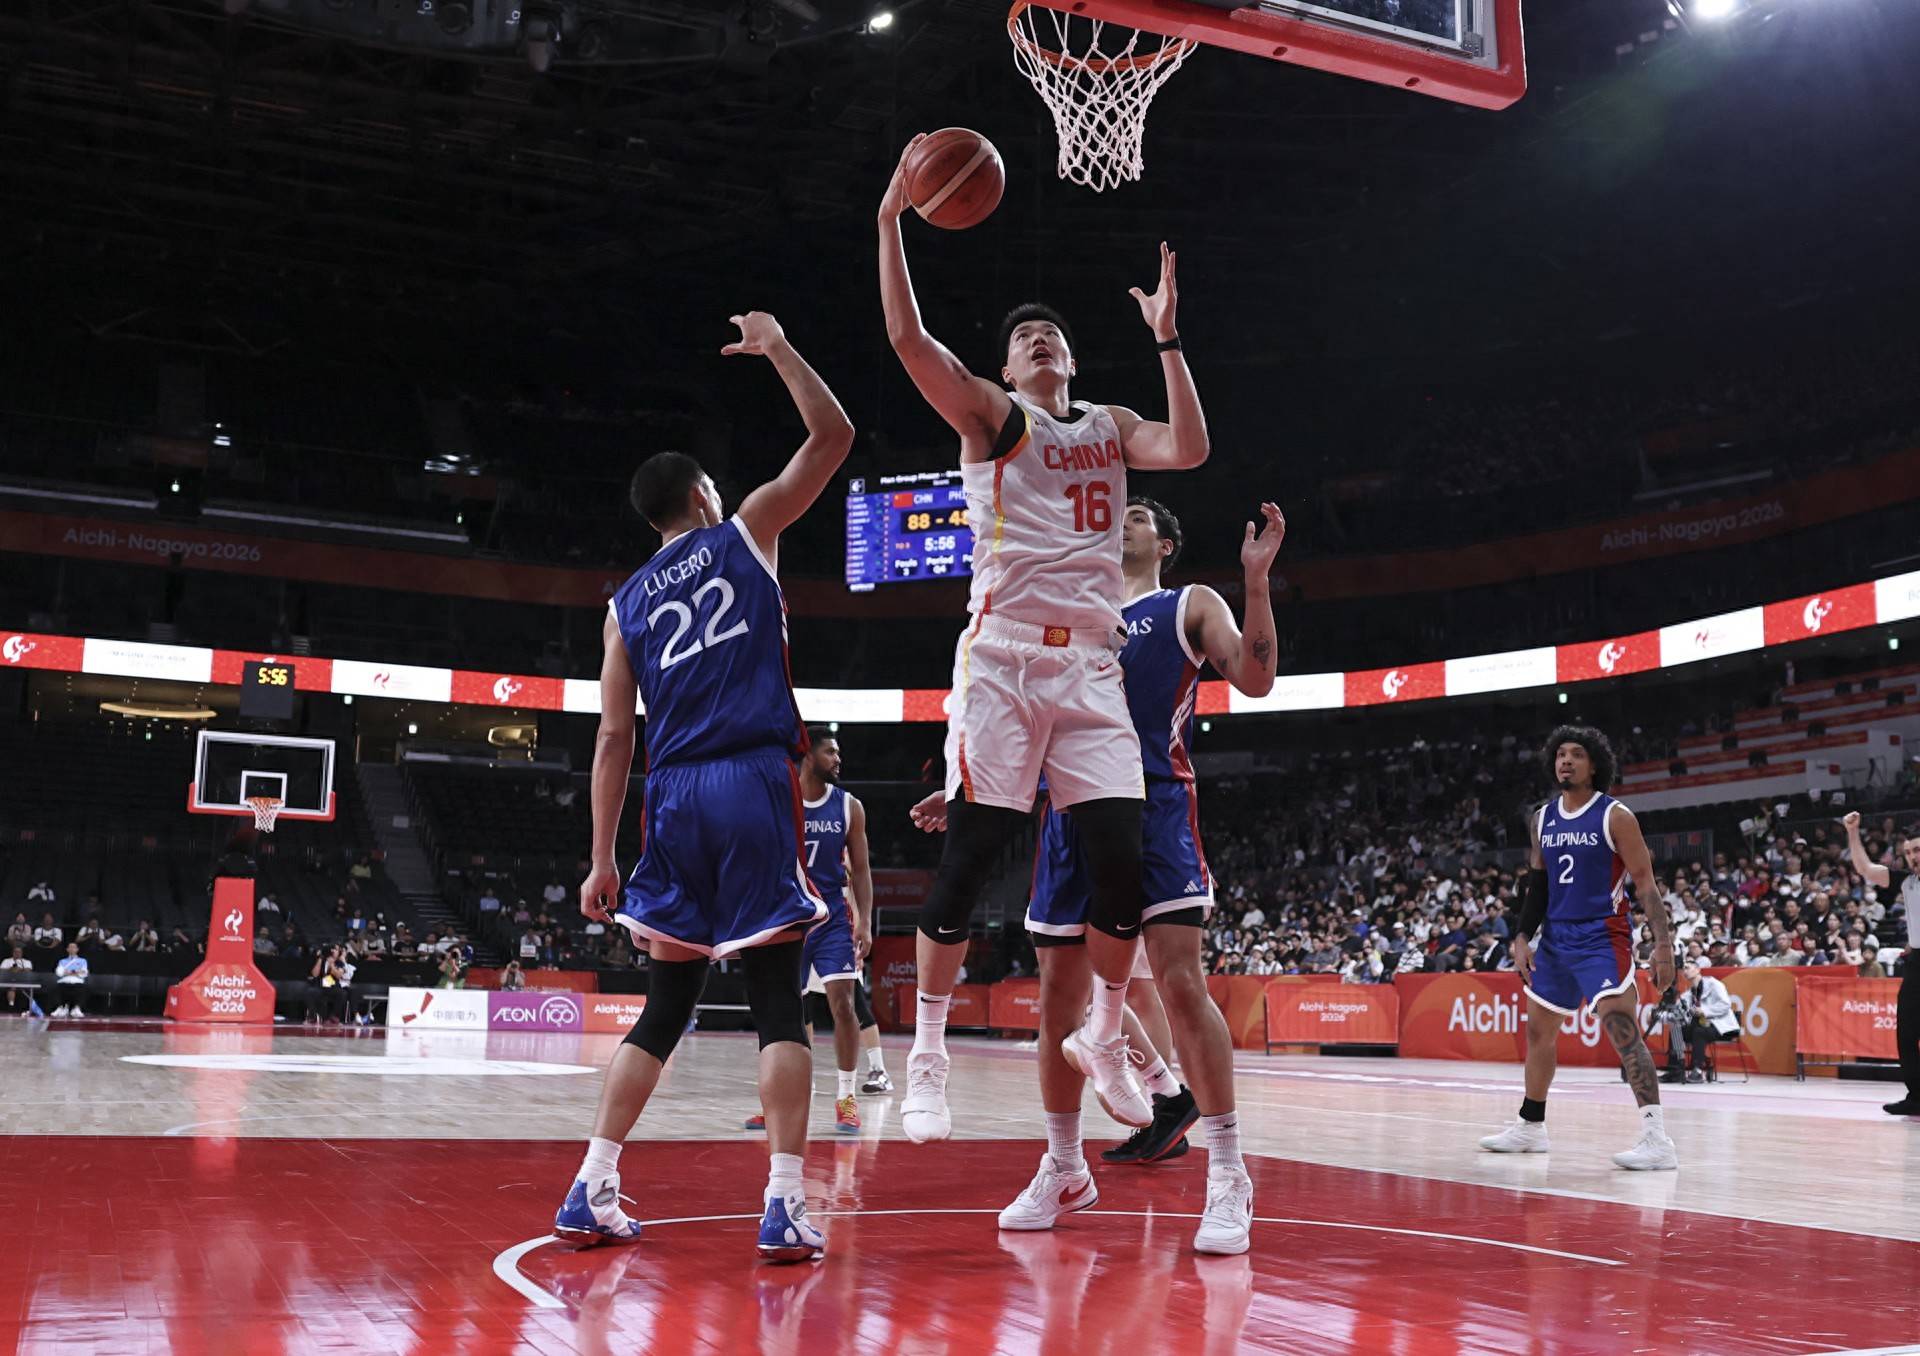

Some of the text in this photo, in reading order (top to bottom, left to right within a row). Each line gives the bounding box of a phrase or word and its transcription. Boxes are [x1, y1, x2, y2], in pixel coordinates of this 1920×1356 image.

[1043, 439, 1120, 472] CHINA
[913, 493, 933, 504] CHN
[1064, 481, 1112, 532] 16
[907, 512, 931, 531] 88
[1599, 501, 1784, 551] Aichi-Nagoya 2026
[63, 527, 261, 562] Aichi-Nagoya 2026
[924, 535, 956, 552] 5:56
[925, 555, 954, 566] Period
[643, 547, 712, 596] LUCERO
[647, 577, 749, 670] 22
[258, 666, 288, 686] 5:56
[804, 820, 842, 833] PINAS
[1541, 831, 1599, 849] PILIPINAS
[804, 840, 819, 868] 7
[1558, 853, 1574, 884] 2
[210, 974, 252, 987] Aichi-
[203, 986, 257, 1001] Nagoya
[211, 1001, 246, 1014] 2026
[1298, 1001, 1368, 1014] Aichi-Nagoya
[1320, 1012, 1346, 1022] 2026
